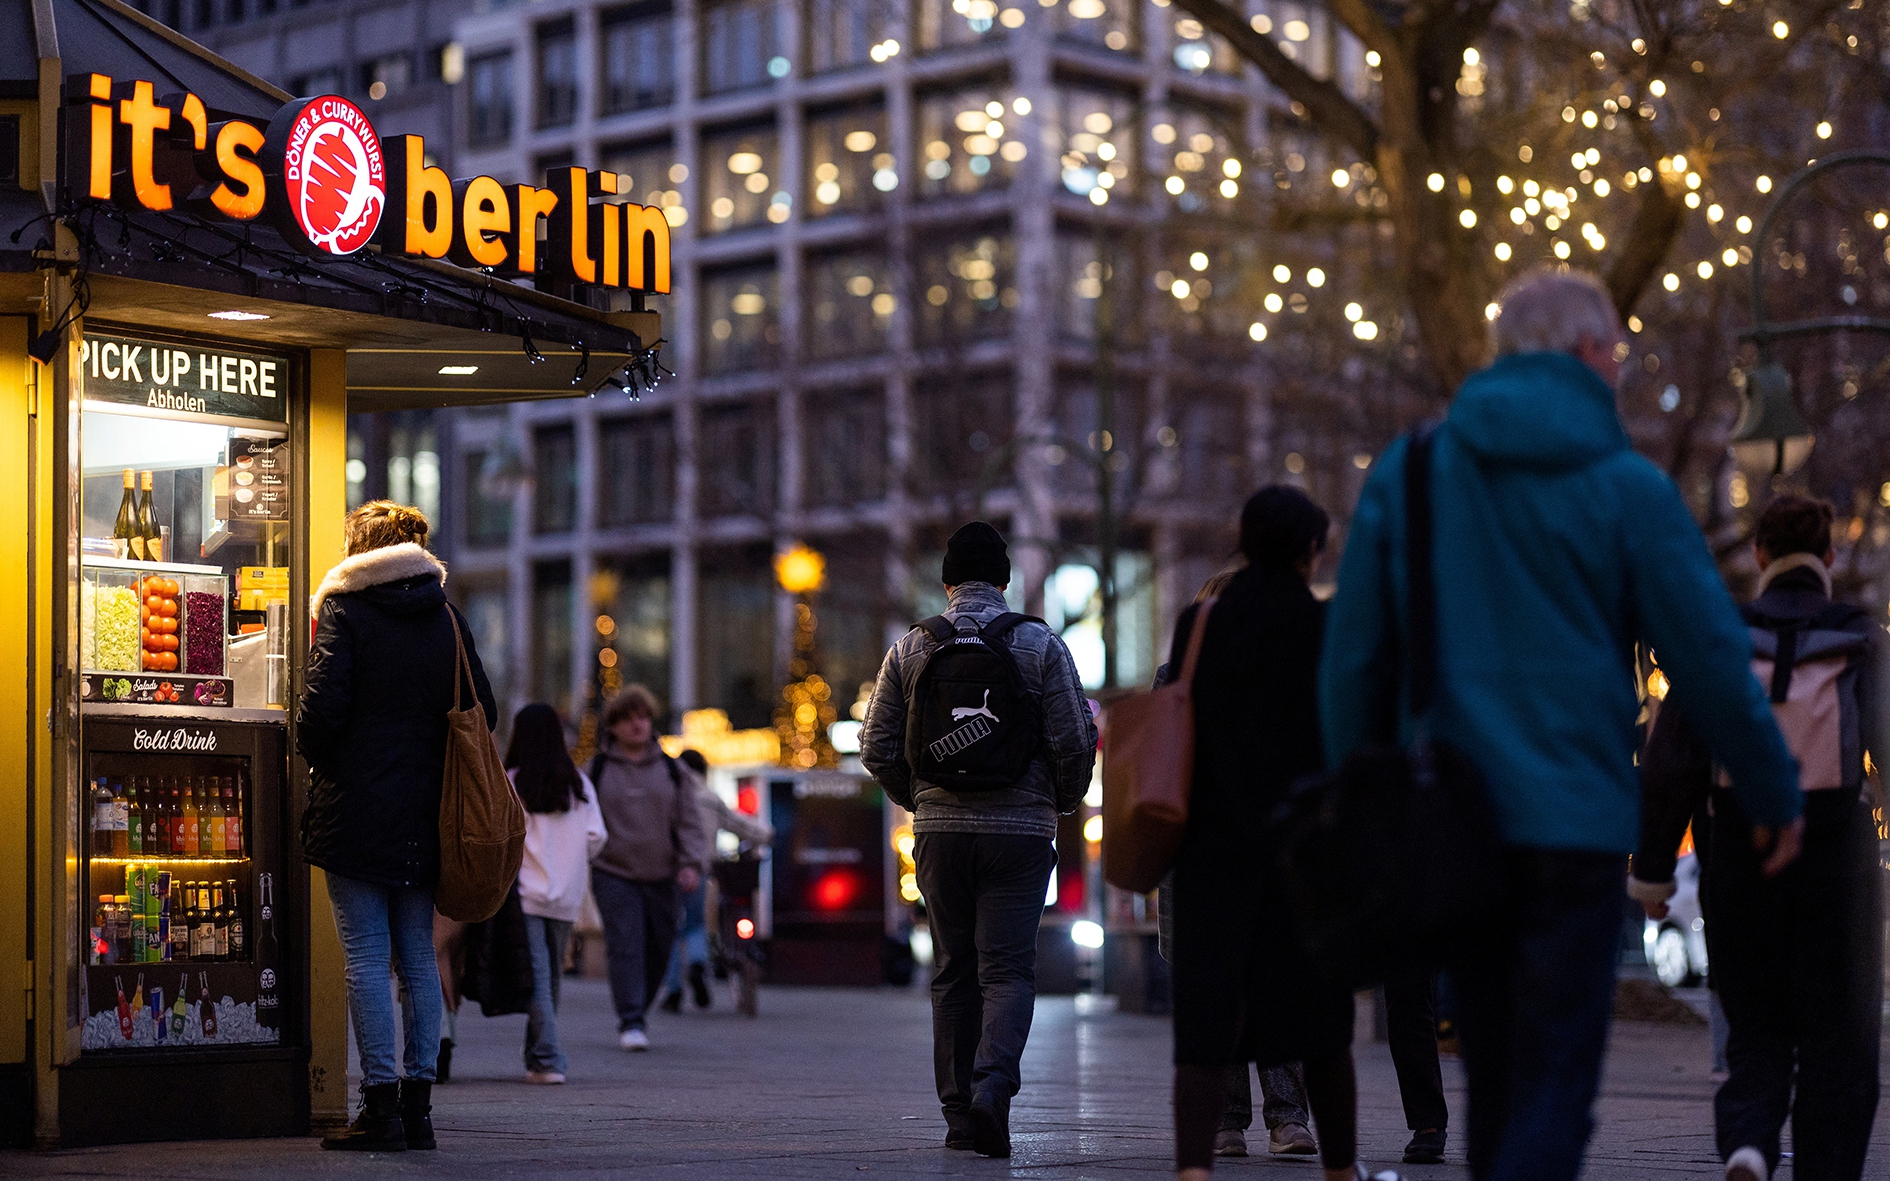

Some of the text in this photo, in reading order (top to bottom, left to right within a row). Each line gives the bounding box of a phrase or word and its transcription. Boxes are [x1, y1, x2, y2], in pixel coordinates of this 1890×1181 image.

[286, 101, 383, 182] DÖNER & CURRYWURST
[89, 73, 671, 295] it's berlin
[151, 348, 191, 387] UP
[200, 353, 276, 398] HERE
[147, 388, 206, 412] Abholen
[133, 728, 217, 751] Cold Drink
[929, 715, 992, 763] PUMA
